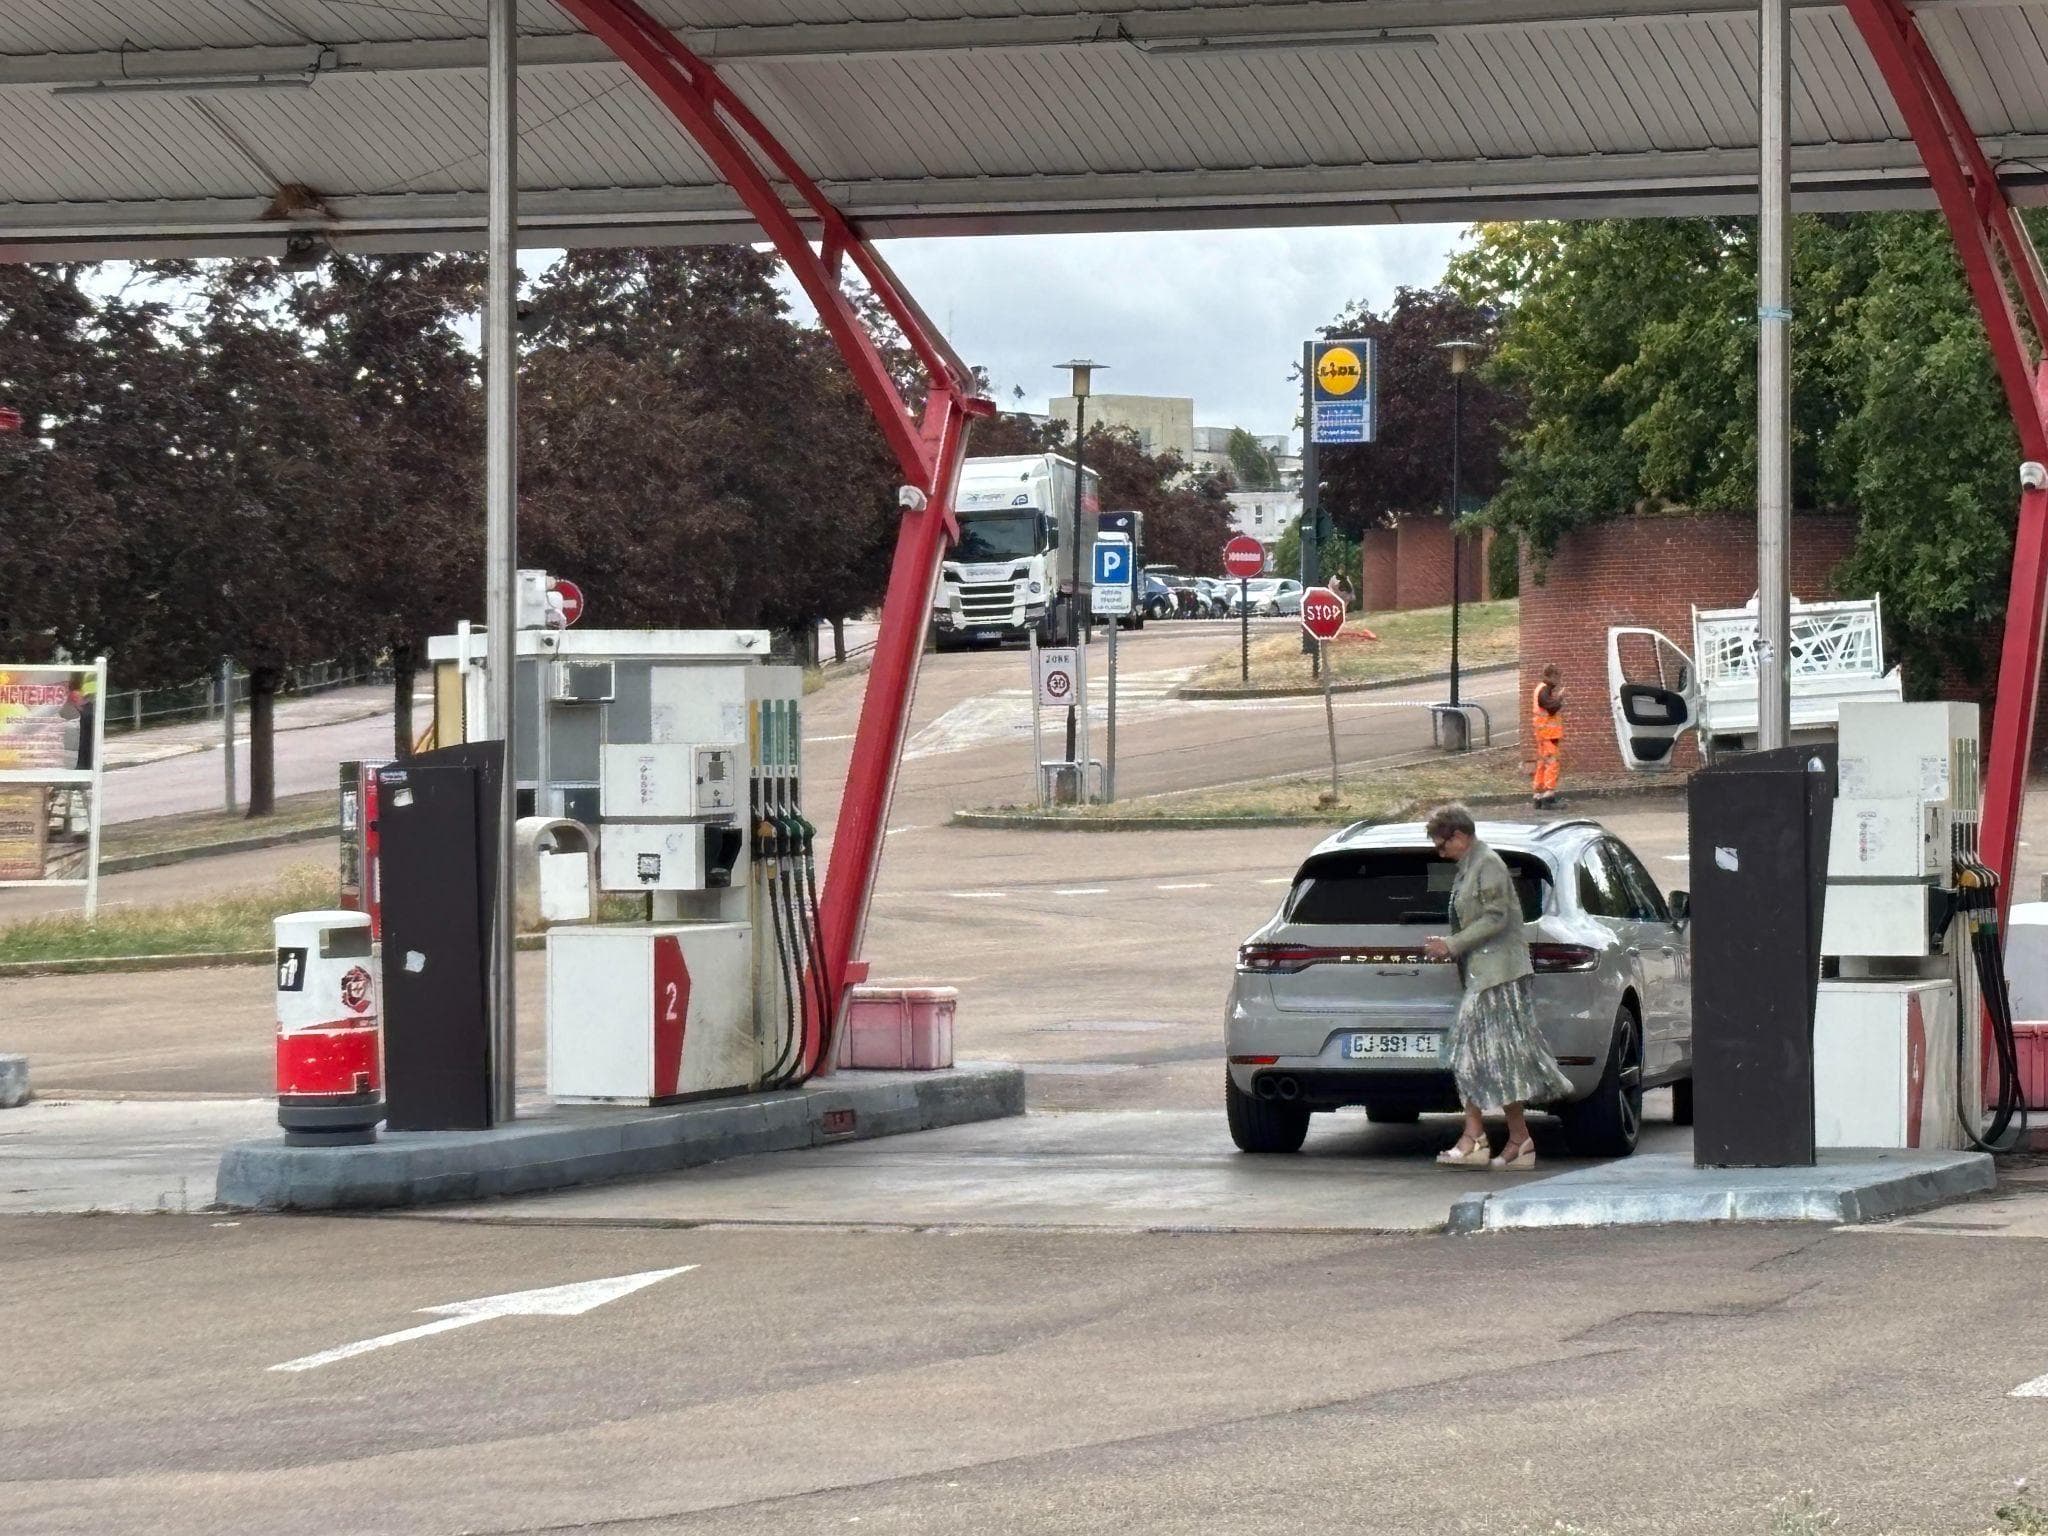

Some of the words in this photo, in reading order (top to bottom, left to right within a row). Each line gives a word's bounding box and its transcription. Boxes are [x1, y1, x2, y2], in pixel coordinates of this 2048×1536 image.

[1103, 551, 1121, 578] P
[1306, 604, 1341, 621] STOP
[1045, 655, 1070, 663] ZONE
[1051, 677, 1066, 689] 30
[665, 982, 678, 1021] 2
